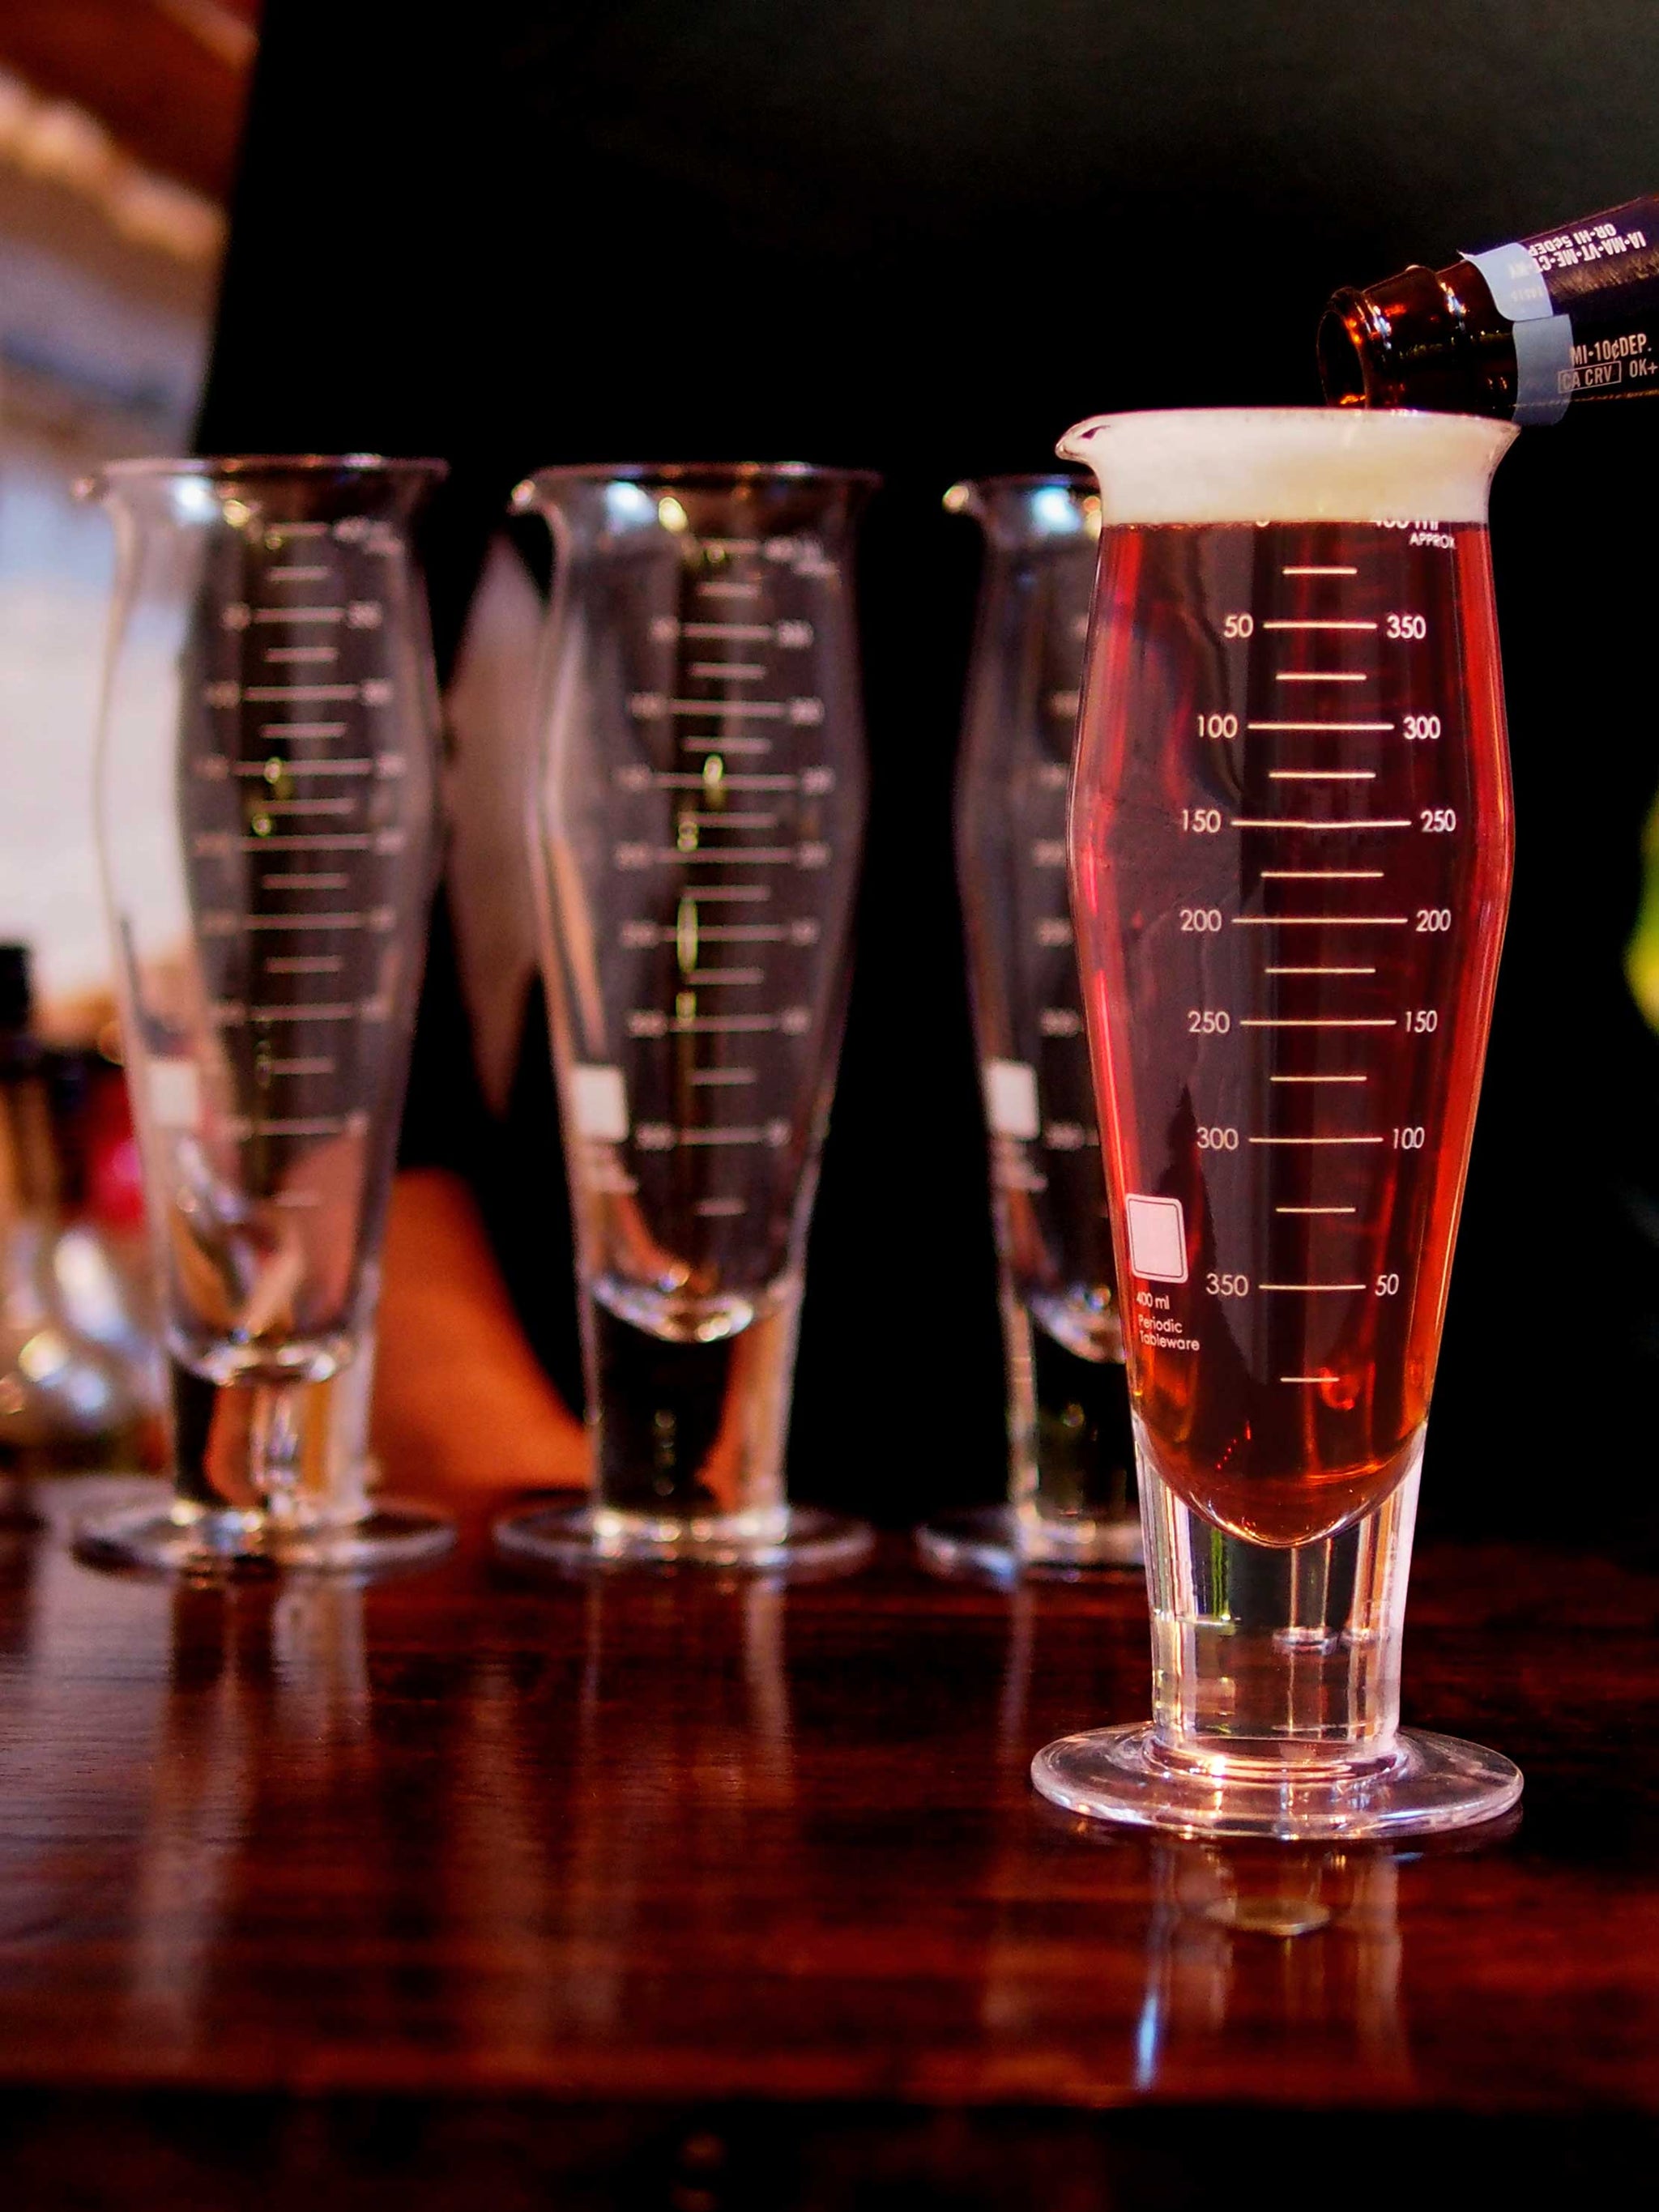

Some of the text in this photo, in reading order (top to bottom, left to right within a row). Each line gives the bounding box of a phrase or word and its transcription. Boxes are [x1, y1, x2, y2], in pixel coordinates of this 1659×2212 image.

[1562, 371, 1580, 390] CA
[1584, 364, 1612, 386] CRV
[1222, 613, 1255, 639] 50
[1386, 613, 1427, 640] 350
[1196, 714, 1239, 739] 100
[1403, 715, 1442, 740] 300
[1182, 809, 1222, 833] 150
[1420, 808, 1457, 833] 250
[1179, 909, 1222, 932] 200
[1414, 908, 1452, 932] 200
[1188, 1010, 1230, 1034] 250
[1405, 1009, 1439, 1034] 150
[1196, 1127, 1240, 1151] 300
[1392, 1127, 1426, 1150] 100
[1205, 1272, 1249, 1297] 350
[1375, 1273, 1400, 1297] 50
[1136, 1291, 1171, 1311] 400 ml
[1138, 1314, 1183, 1334] Periodic
[1139, 1330, 1201, 1352] Tableware
